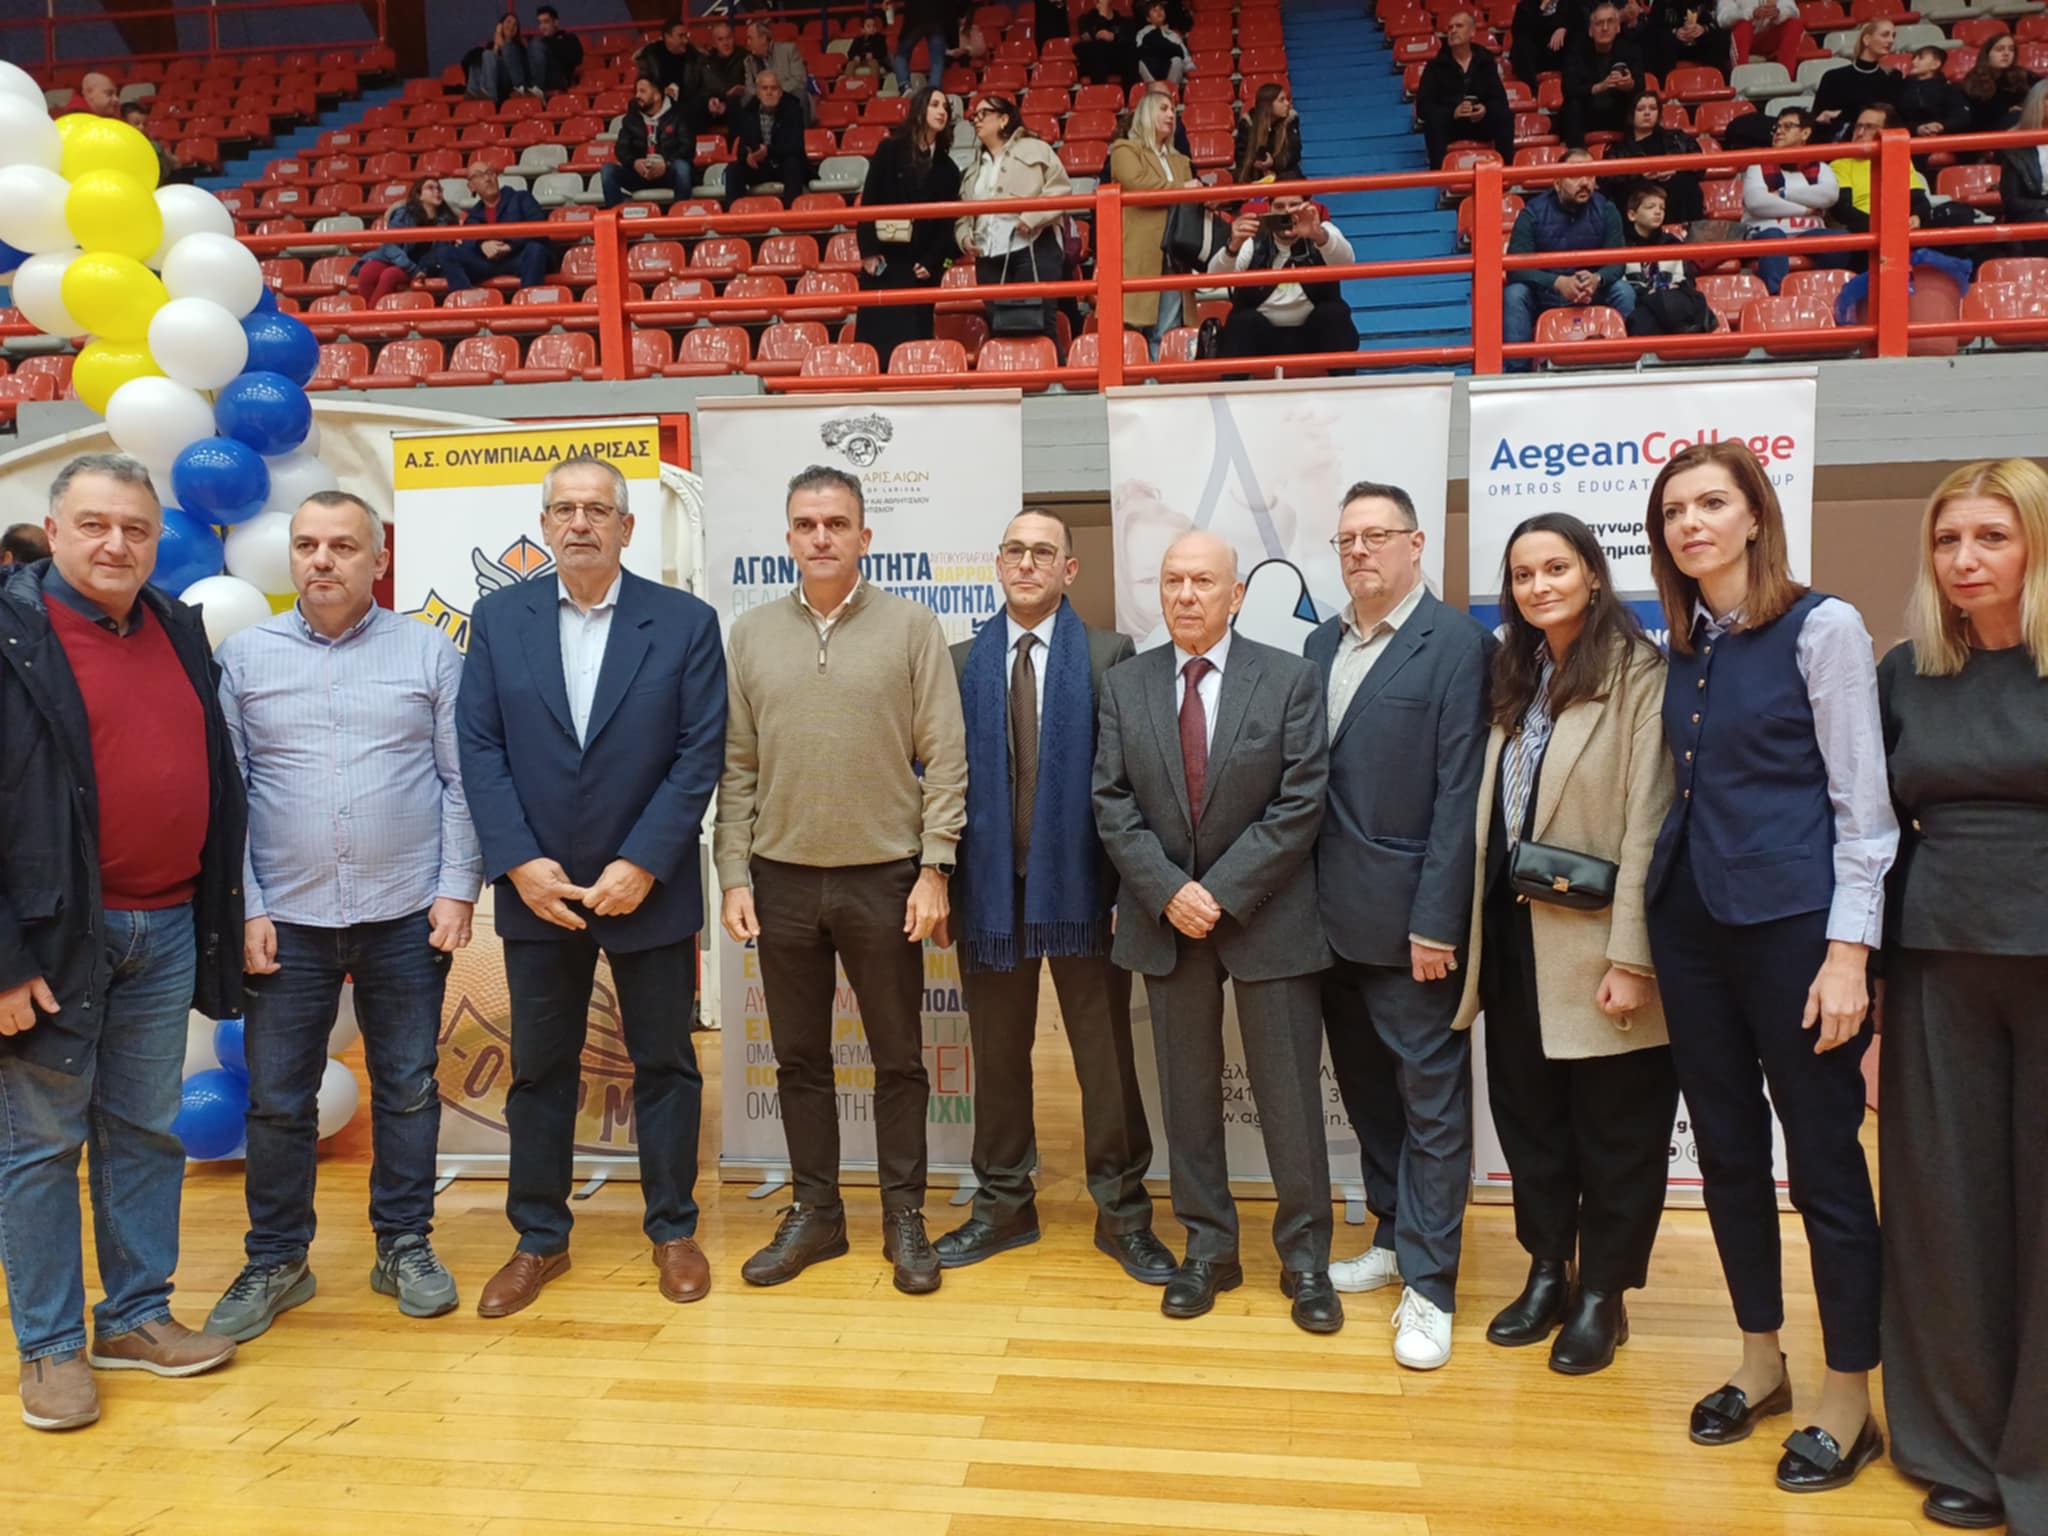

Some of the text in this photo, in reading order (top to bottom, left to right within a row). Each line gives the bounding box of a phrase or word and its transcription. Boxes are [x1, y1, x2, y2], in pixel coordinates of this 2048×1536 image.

[404, 439, 650, 468] Α.Σ. ΟΛΥΜΠΙΑΔΑ ΛΑΡΙΣΑΣ
[863, 471, 929, 483] ΑΡΙΣΑΙΩΝ
[1488, 478, 1651, 496] OMIROS EDUCAT
